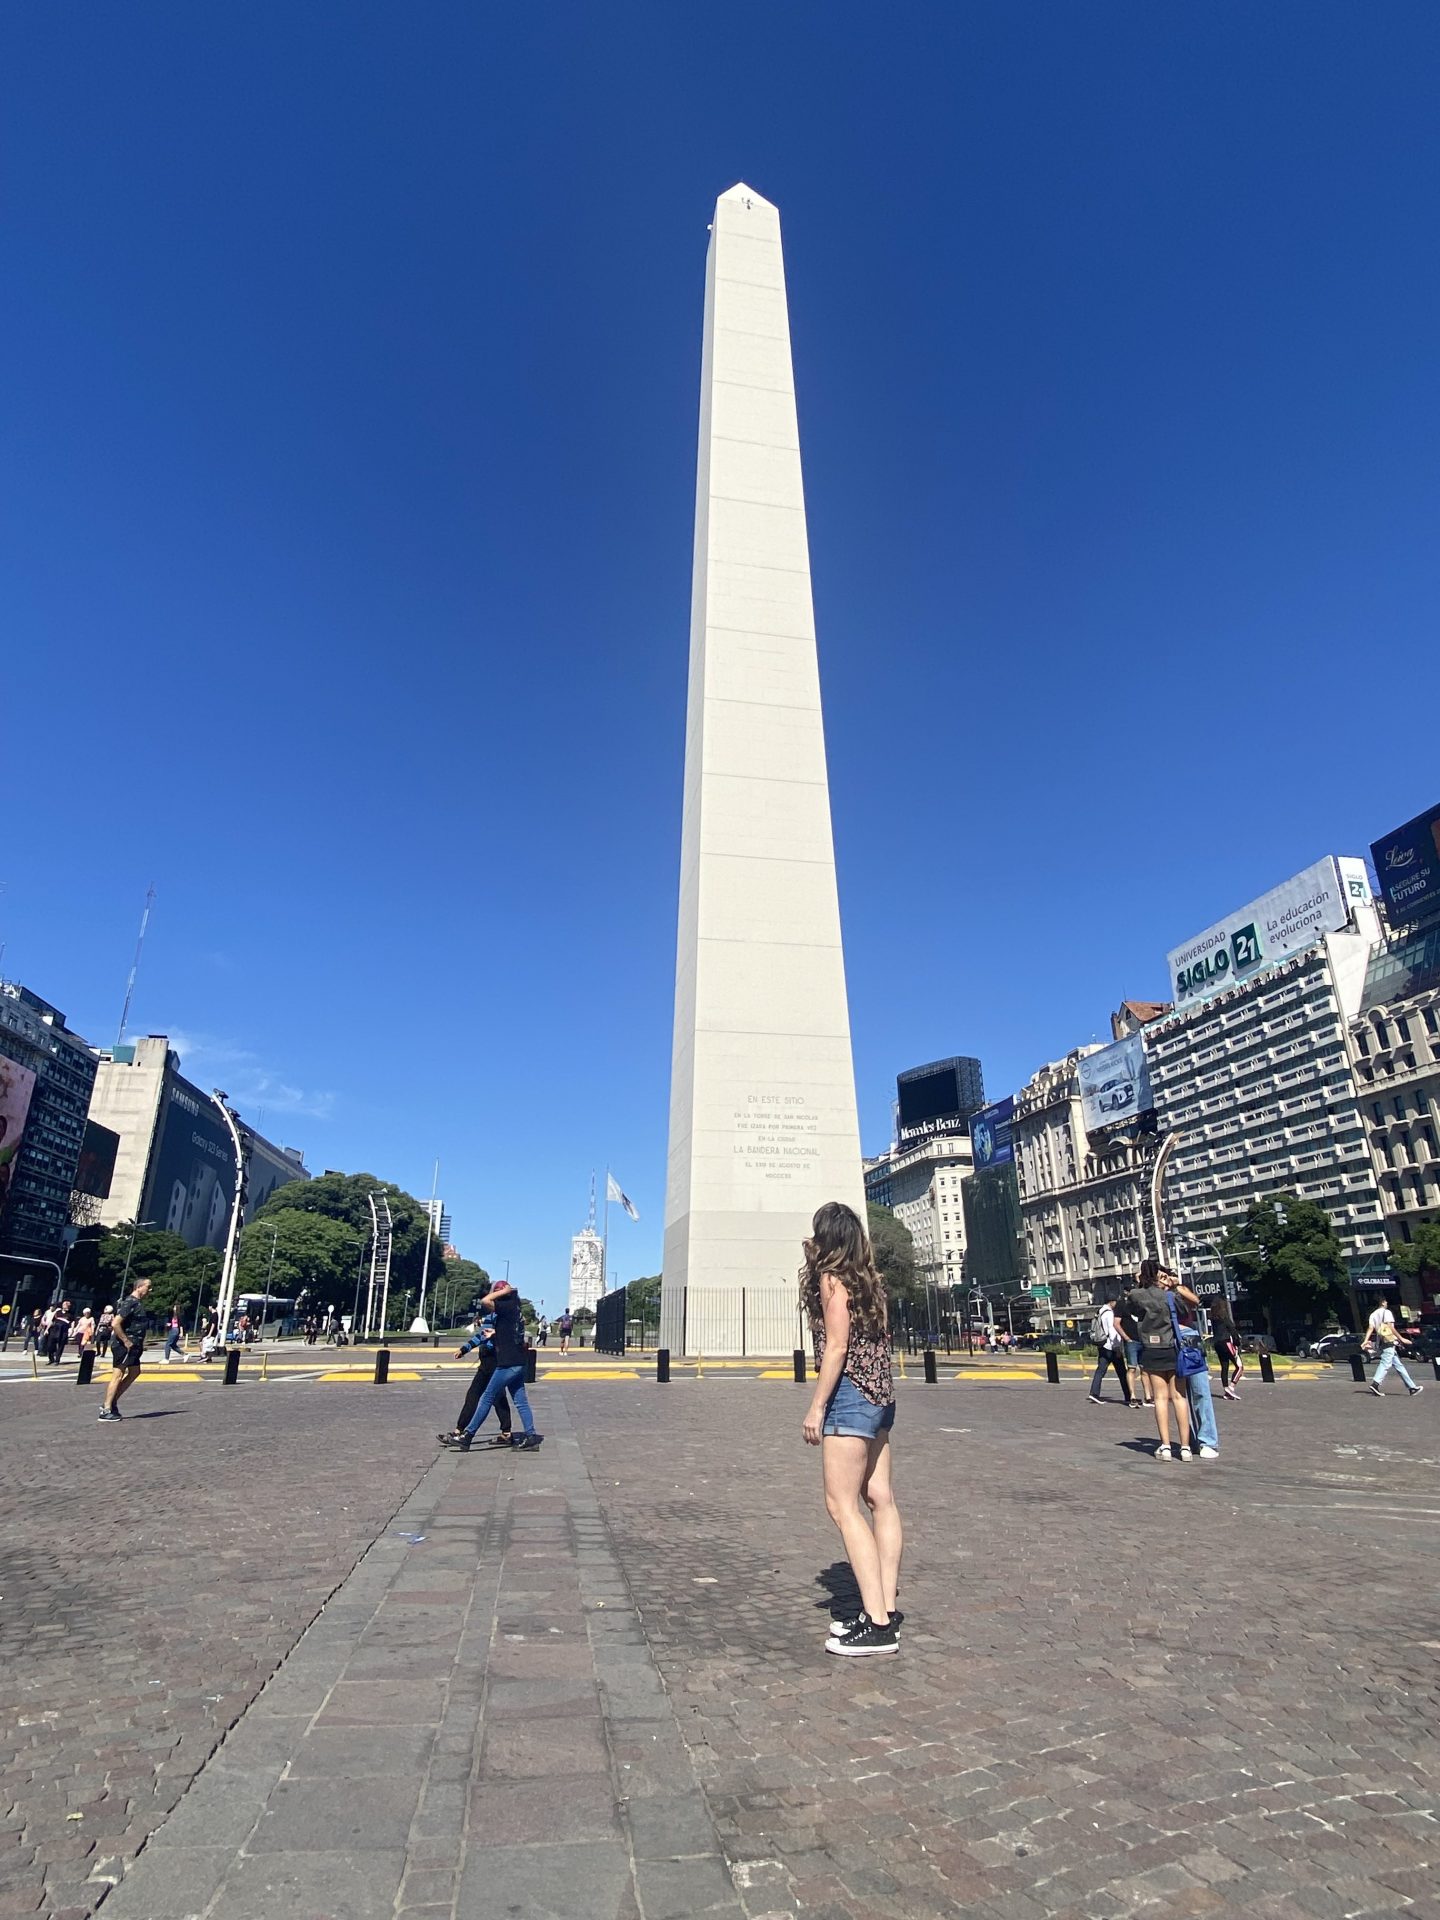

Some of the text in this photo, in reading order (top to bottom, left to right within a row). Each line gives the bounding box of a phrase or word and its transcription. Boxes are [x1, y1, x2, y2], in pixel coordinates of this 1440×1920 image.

[1420, 867, 1431, 877] SU
[1351, 883, 1367, 898] 21
[1392, 879, 1427, 903] FUTURO
[1266, 919, 1278, 932] La
[1269, 910, 1322, 944] evoluciona
[1175, 931, 1226, 967] UNIVERSIDAD
[1236, 935, 1256, 961] 21
[1176, 948, 1230, 993] SIGLO
[171, 1087, 200, 1117] SAMSUNG
[747, 1095, 805, 1105] EN ESTE SITIO
[900, 1117, 961, 1141] Mercedes-Benz
[191, 1131, 208, 1153] Galaxy
[733, 1145, 820, 1156] LA BANDERA NACIONAL
[1195, 1282, 1222, 1295] GLOBA
